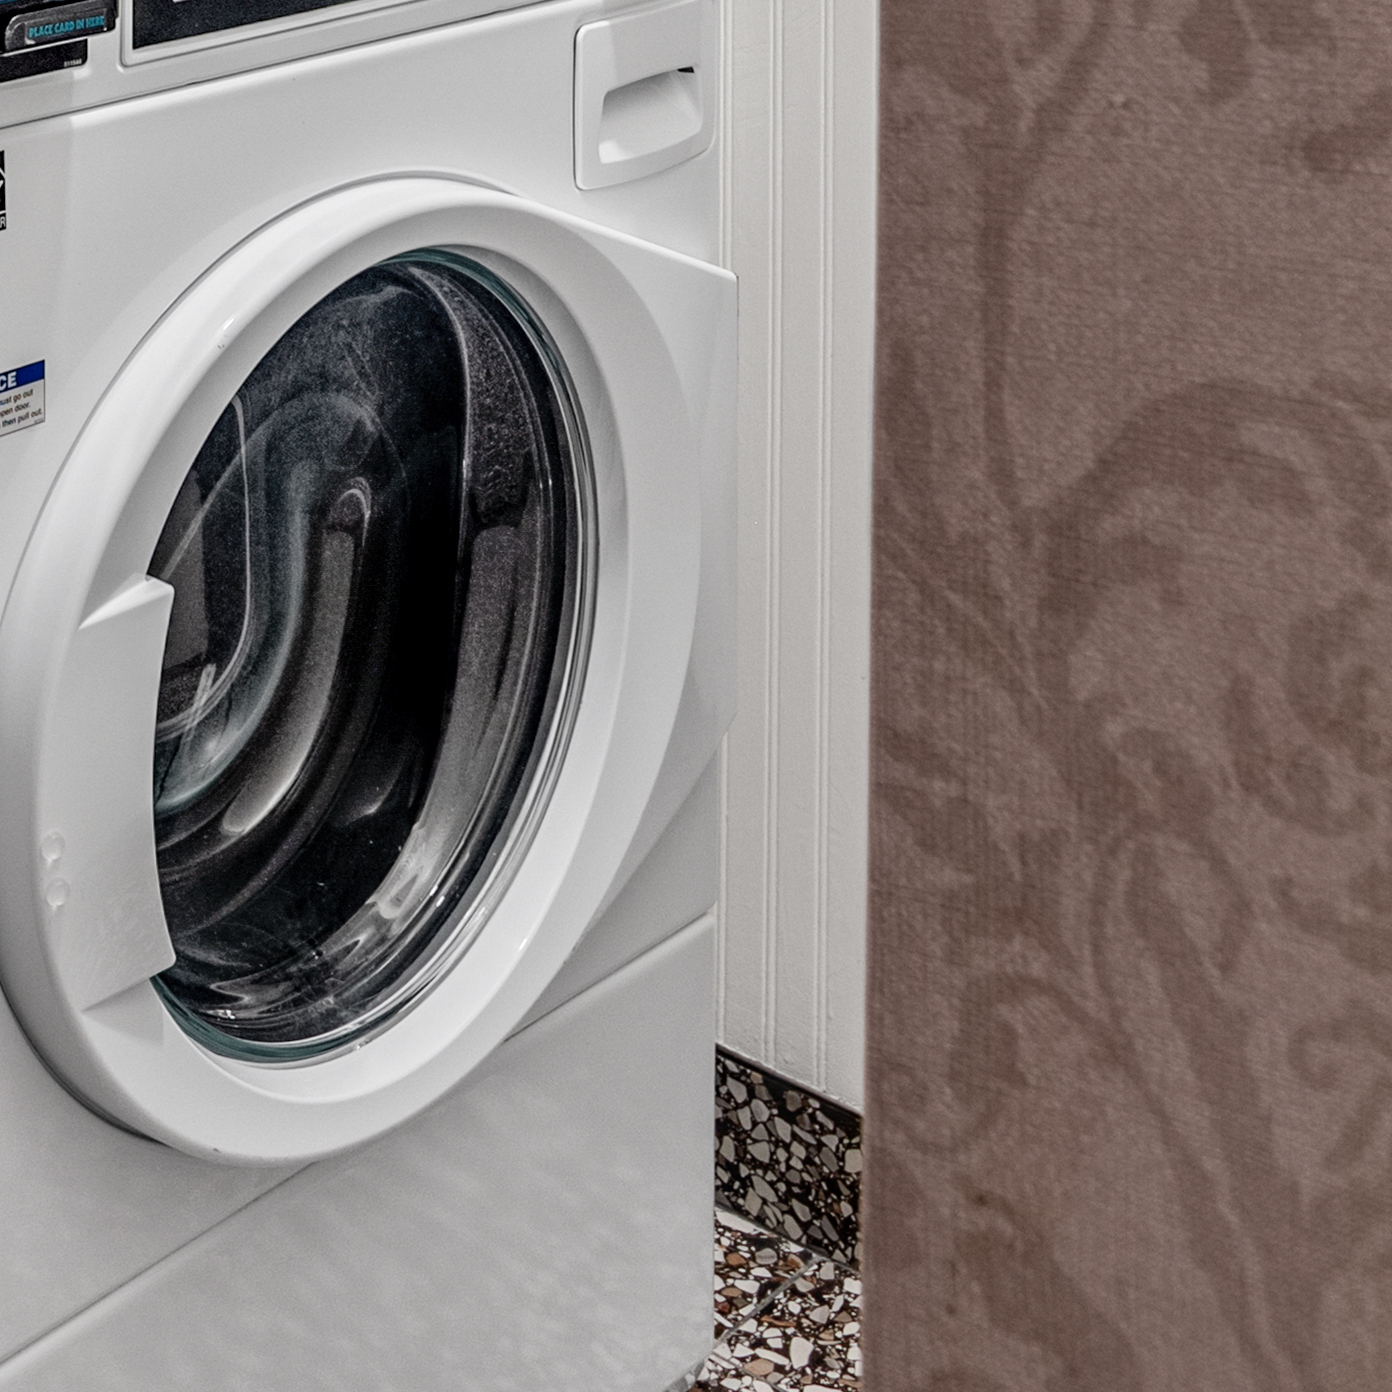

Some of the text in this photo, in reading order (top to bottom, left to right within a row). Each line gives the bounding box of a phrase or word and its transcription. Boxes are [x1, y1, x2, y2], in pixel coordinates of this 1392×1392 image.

[29, 24, 53, 38] PLACE
[54, 20, 74, 33] CARD
[76, 18, 84, 30] IN
[13, 394, 21, 404] go
[23, 389, 34, 398] out
[2, 417, 16, 427] then
[18, 413, 29, 424] pull
